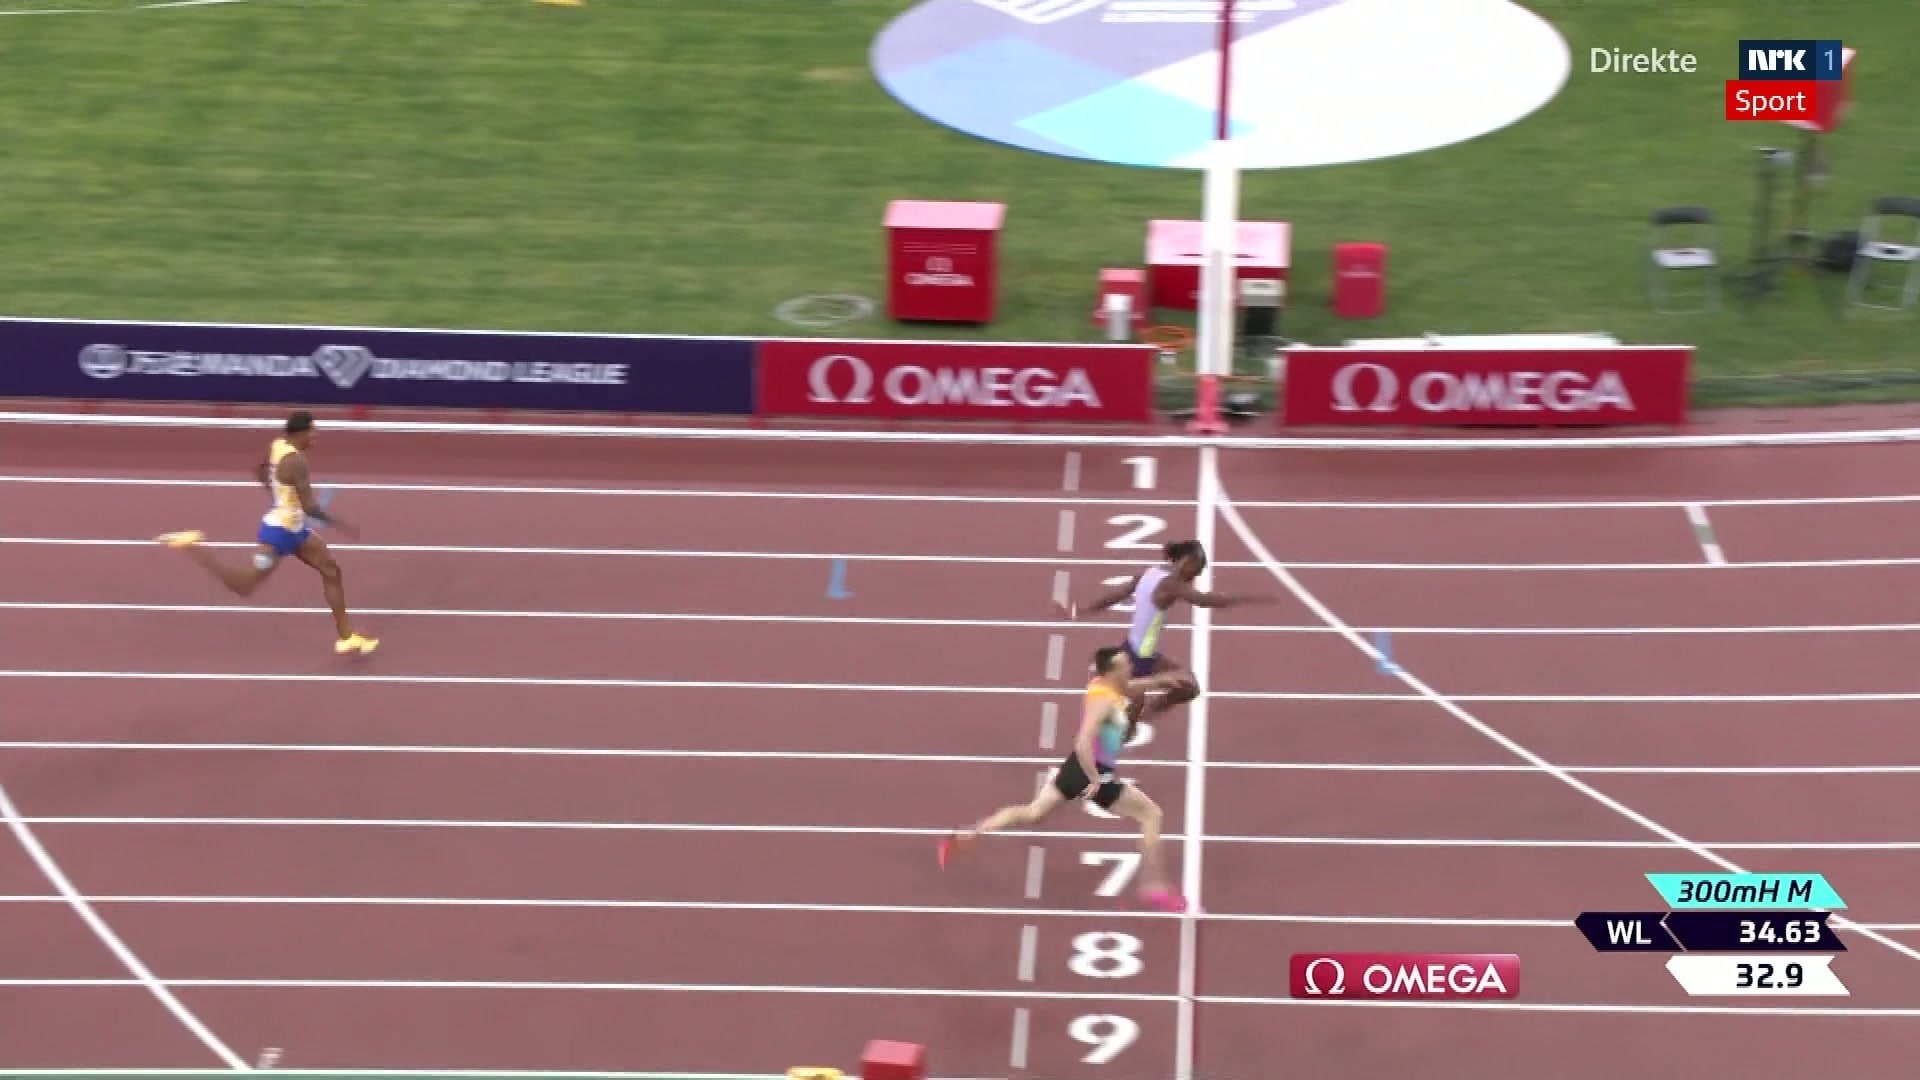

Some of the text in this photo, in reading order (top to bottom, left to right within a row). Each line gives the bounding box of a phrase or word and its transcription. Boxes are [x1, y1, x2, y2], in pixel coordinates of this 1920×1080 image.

[370, 358, 512, 381] DIAMOND
[512, 361, 630, 385] LEAGUE
[883, 364, 1103, 408] OMEGA
[1408, 370, 1637, 412] OMEGA
[1120, 456, 1158, 489] 1
[1103, 514, 1168, 549] 2
[1079, 852, 1143, 897] 7
[1067, 931, 1144, 978] 8
[1067, 1013, 1140, 1065] 9
